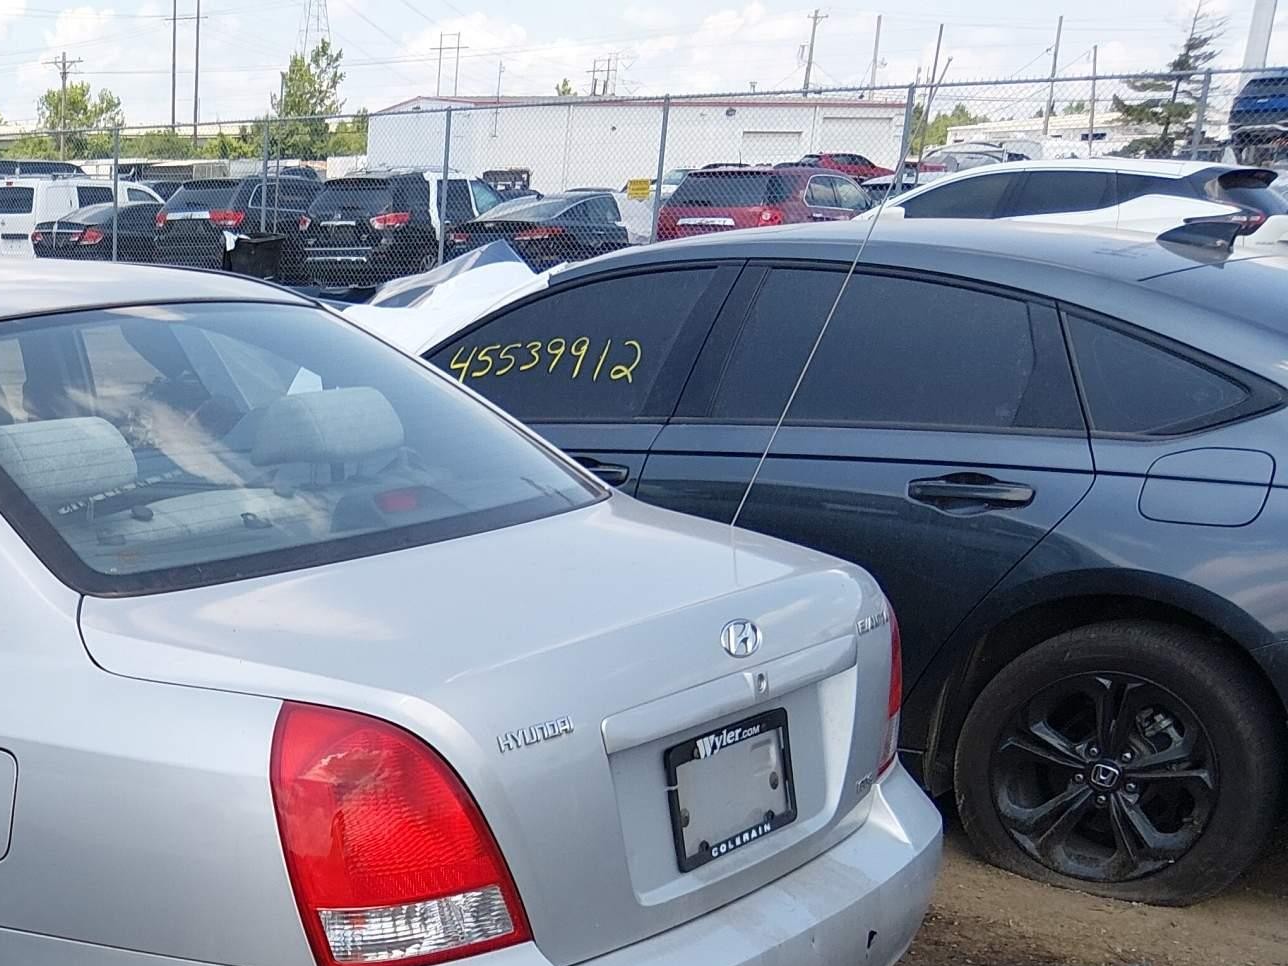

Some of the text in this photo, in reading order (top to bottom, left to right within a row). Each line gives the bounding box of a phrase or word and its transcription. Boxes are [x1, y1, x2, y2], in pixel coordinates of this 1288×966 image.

[450, 336, 642, 384] 45539912
[497, 716, 574, 753] HYUNDAI
[711, 823, 771, 857] COLERAIN
